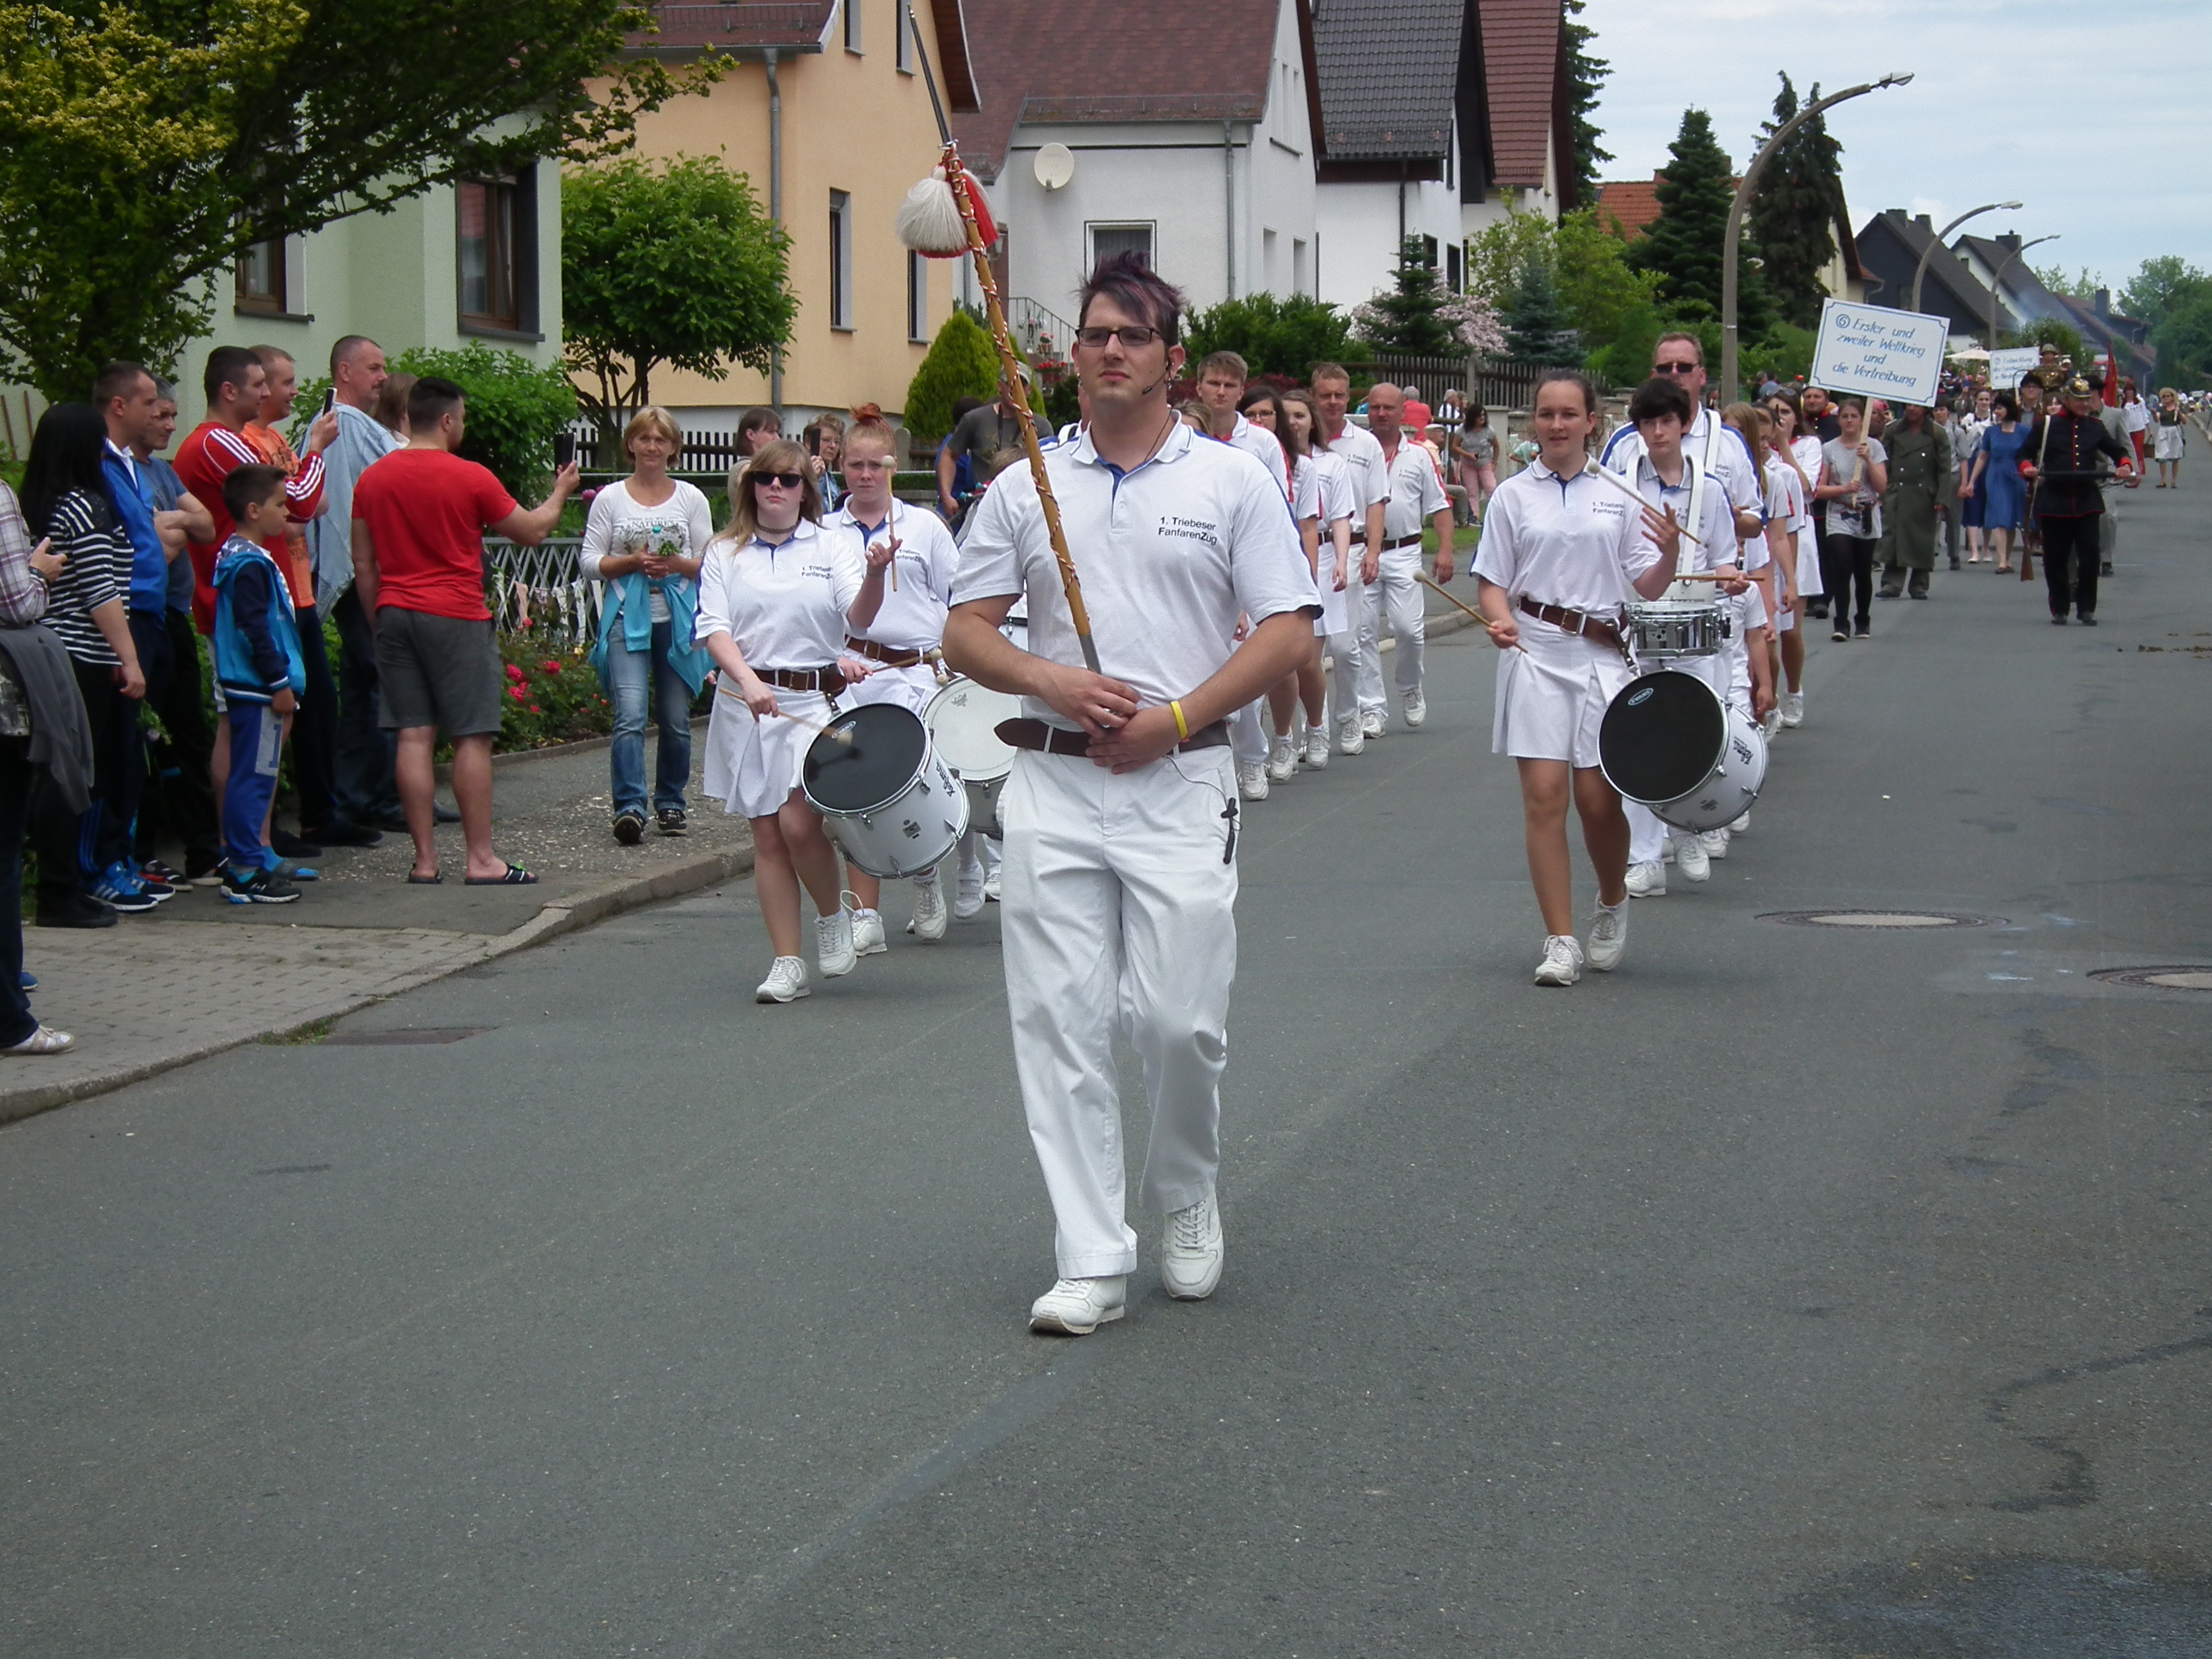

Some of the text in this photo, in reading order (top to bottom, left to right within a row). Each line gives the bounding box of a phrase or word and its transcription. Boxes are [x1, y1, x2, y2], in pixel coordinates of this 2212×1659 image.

[1852, 318, 1886, 333] Erster
[1892, 328, 1915, 339] und
[1837, 334, 1926, 358] zweiter Weltkrieg
[1863, 354, 1888, 364] und
[1832, 362, 1917, 387] die Vertreibung
[1160, 516, 1216, 531] 1. Triebeser
[1158, 527, 1218, 546] FanfarenZug
